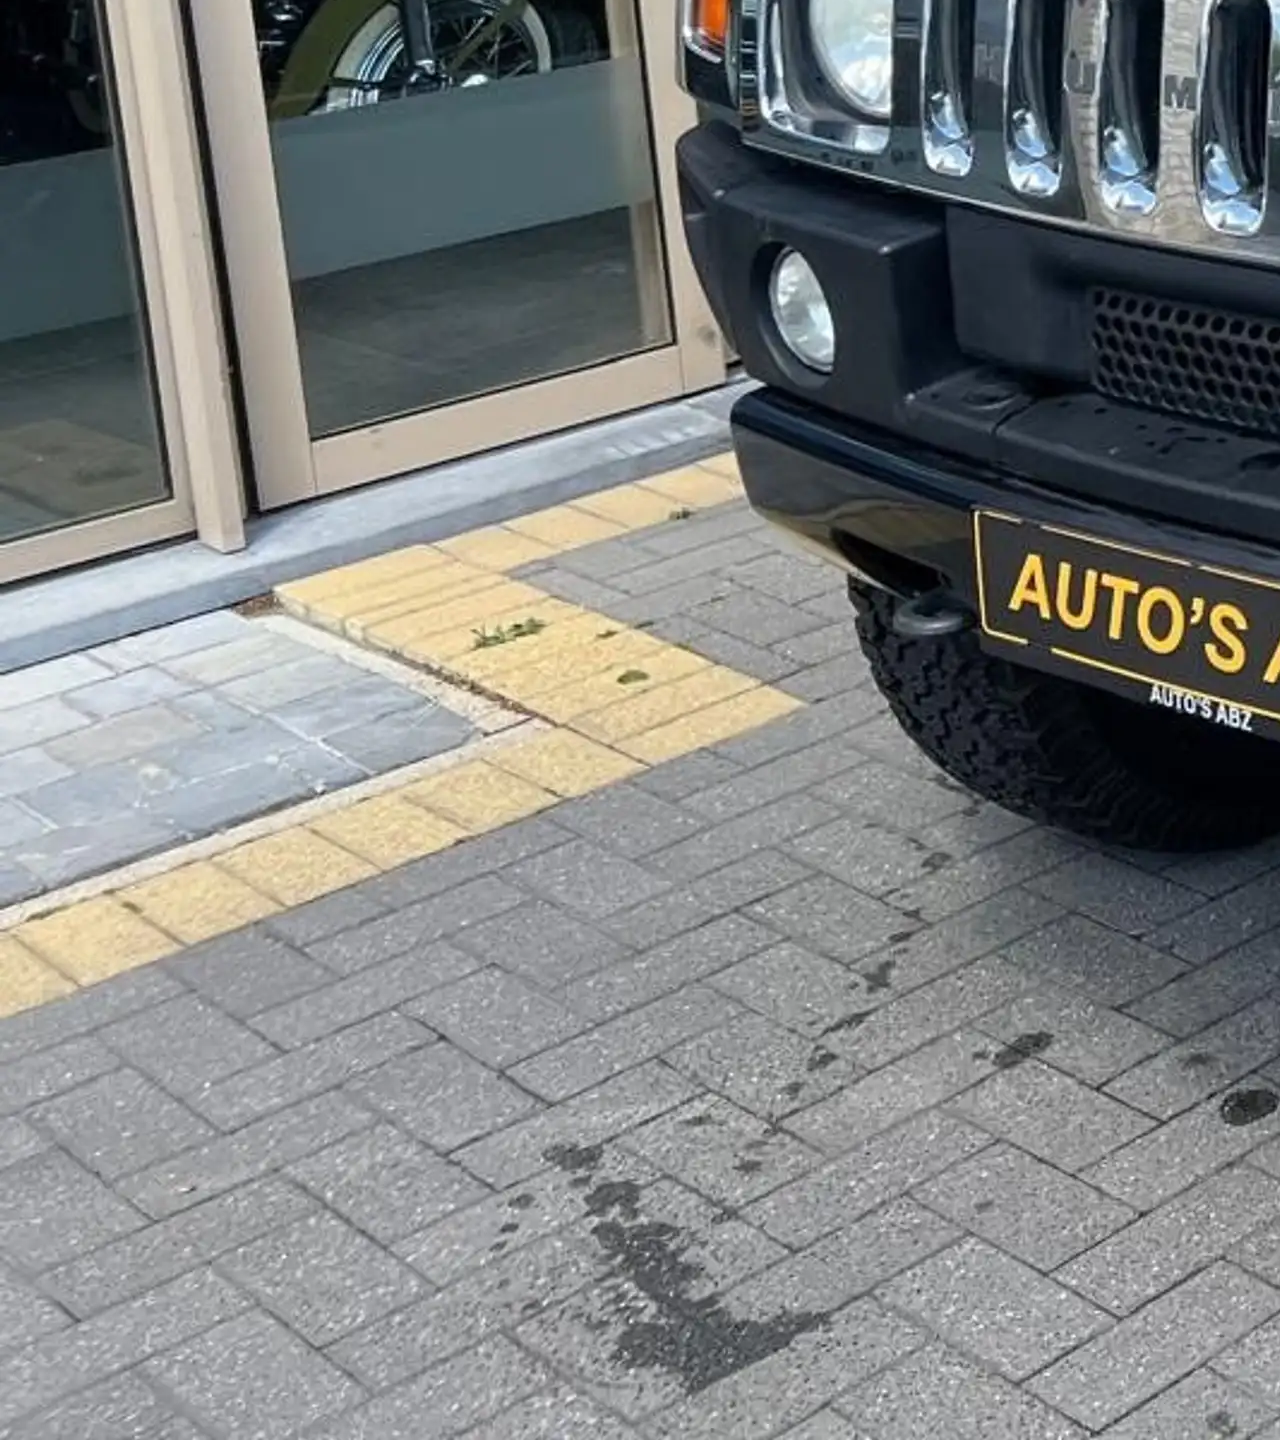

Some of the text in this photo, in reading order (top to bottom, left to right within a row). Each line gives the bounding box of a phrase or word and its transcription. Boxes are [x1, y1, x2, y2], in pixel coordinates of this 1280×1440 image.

[1007, 552, 1249, 674] AUTO'S
[1149, 683, 1253, 732] AUTO'S ABZ
